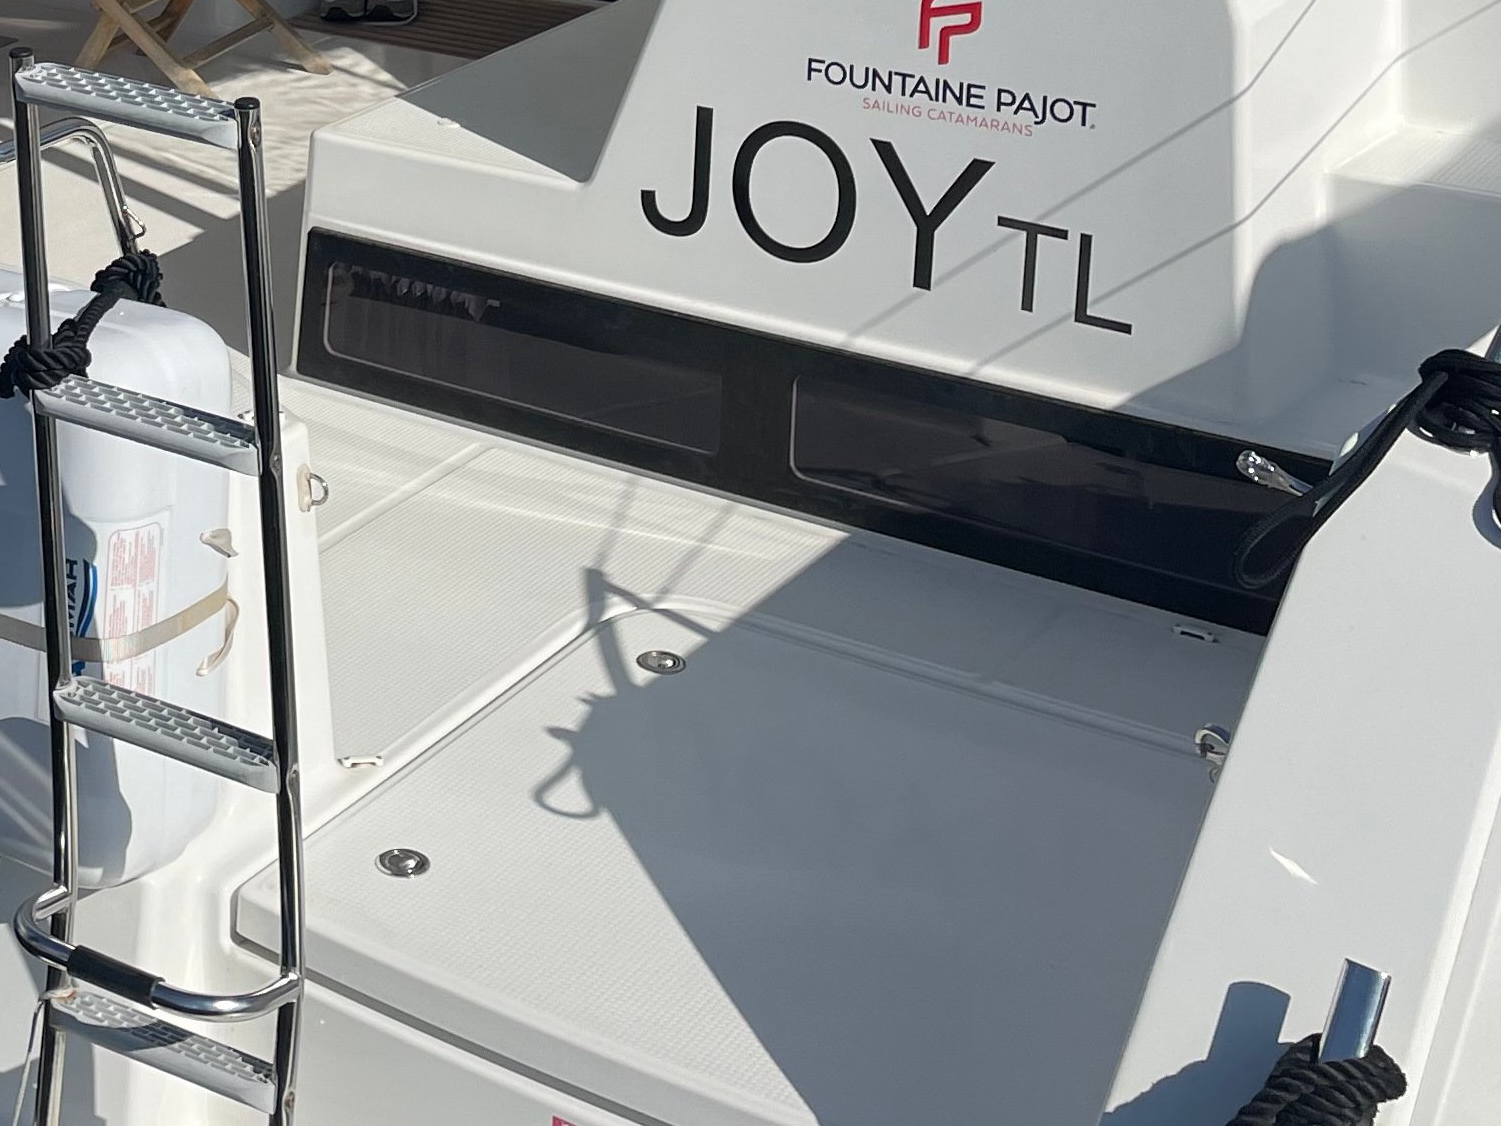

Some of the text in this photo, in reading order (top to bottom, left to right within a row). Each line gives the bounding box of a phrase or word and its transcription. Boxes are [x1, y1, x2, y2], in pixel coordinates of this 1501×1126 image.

[806, 57, 1097, 127] FOUNTAINE PAJOT
[862, 97, 1034, 137] SAILING CATAMARANS
[640, 105, 1133, 335] JOY TL
